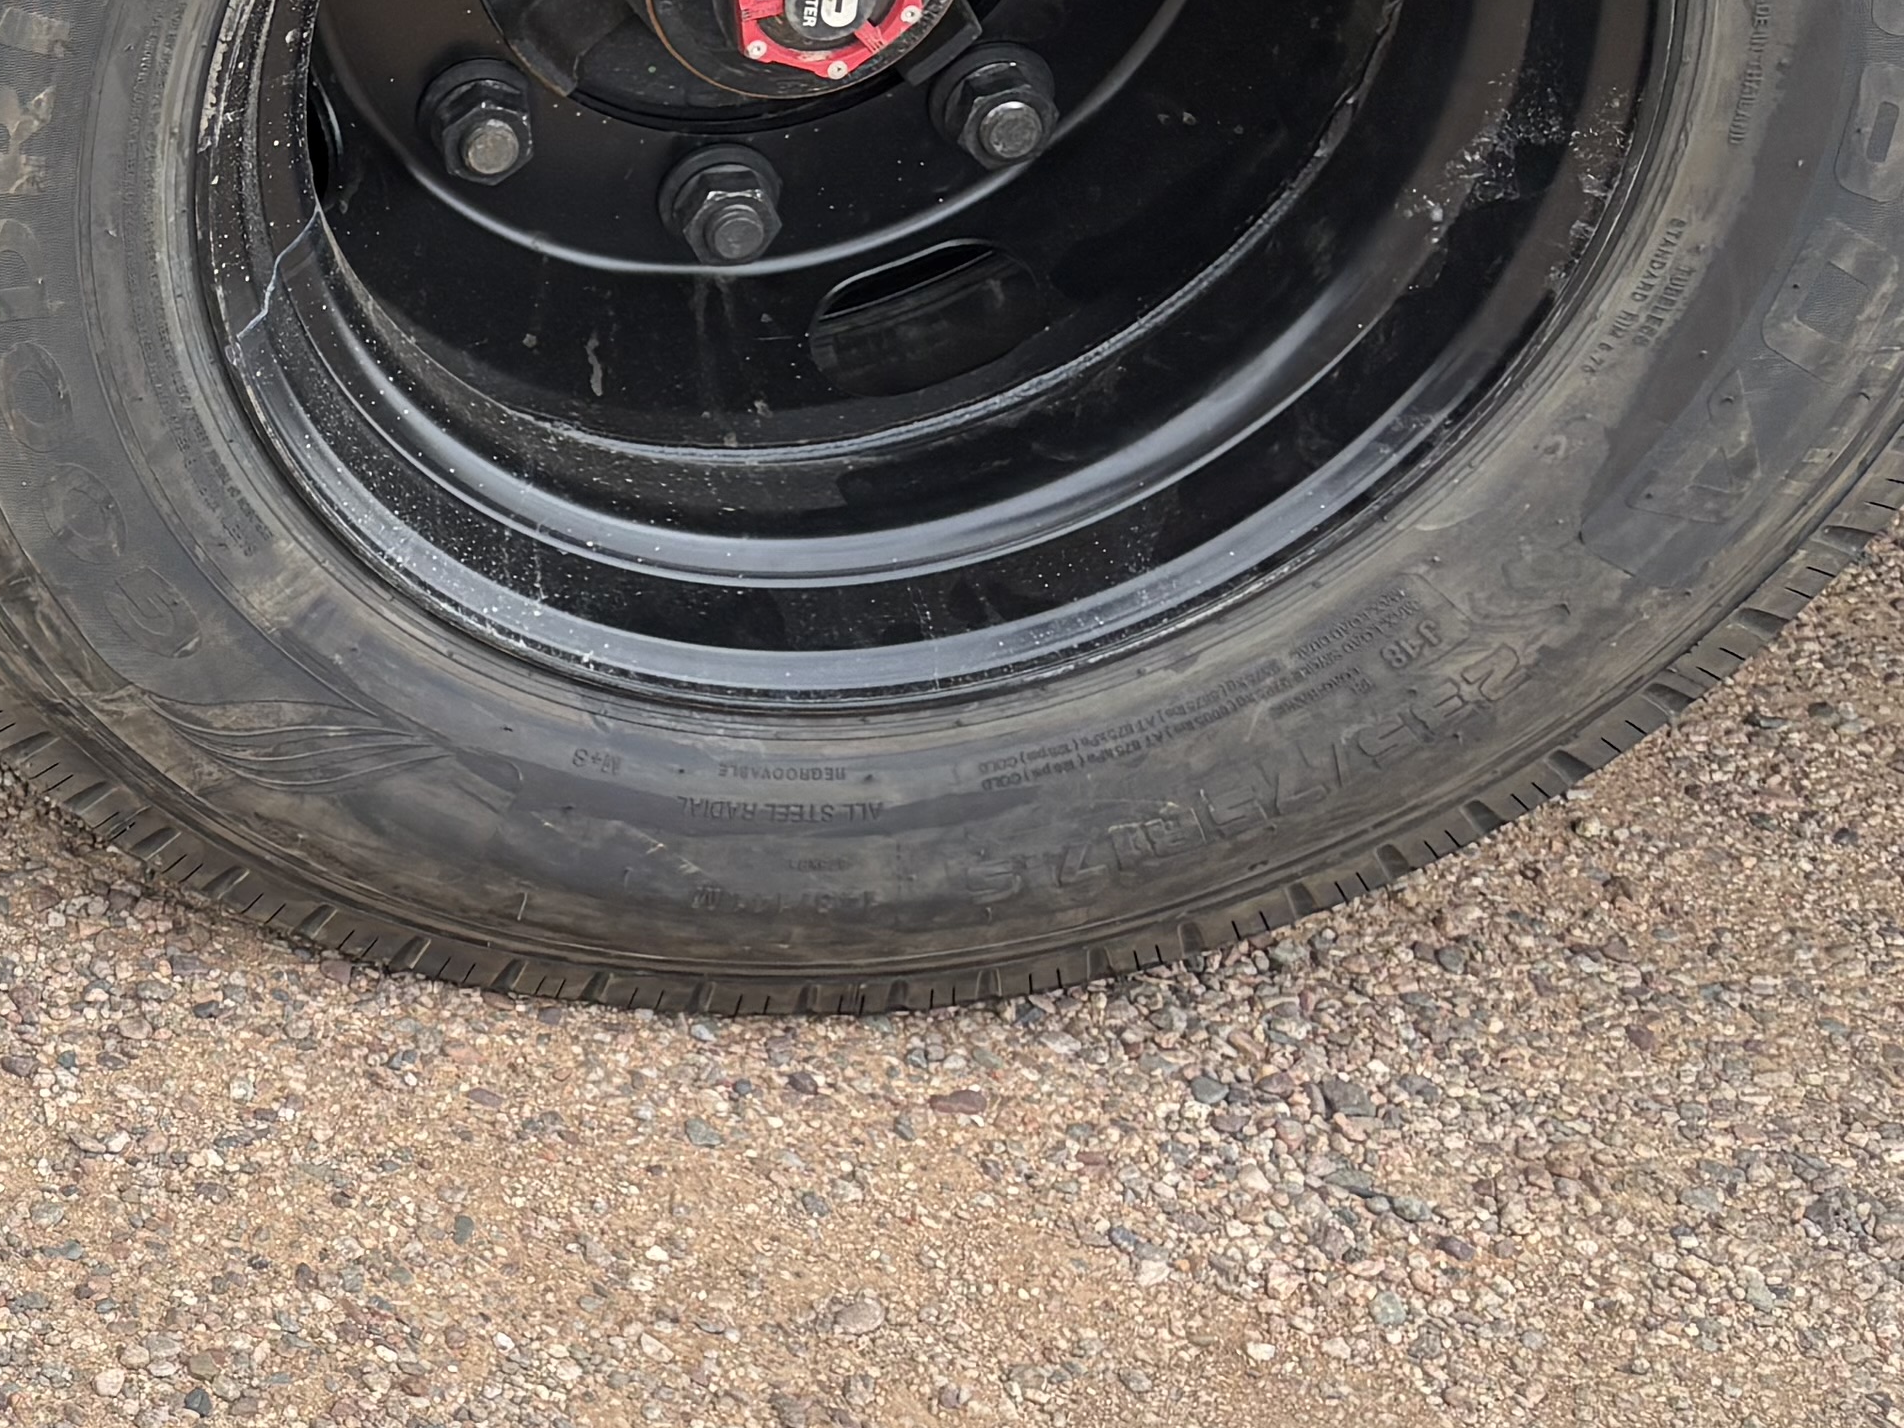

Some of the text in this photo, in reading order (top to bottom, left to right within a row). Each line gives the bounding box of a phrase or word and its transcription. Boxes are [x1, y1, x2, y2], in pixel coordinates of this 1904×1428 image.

[677, 795, 885, 823] ALL STEEL RADIAL
